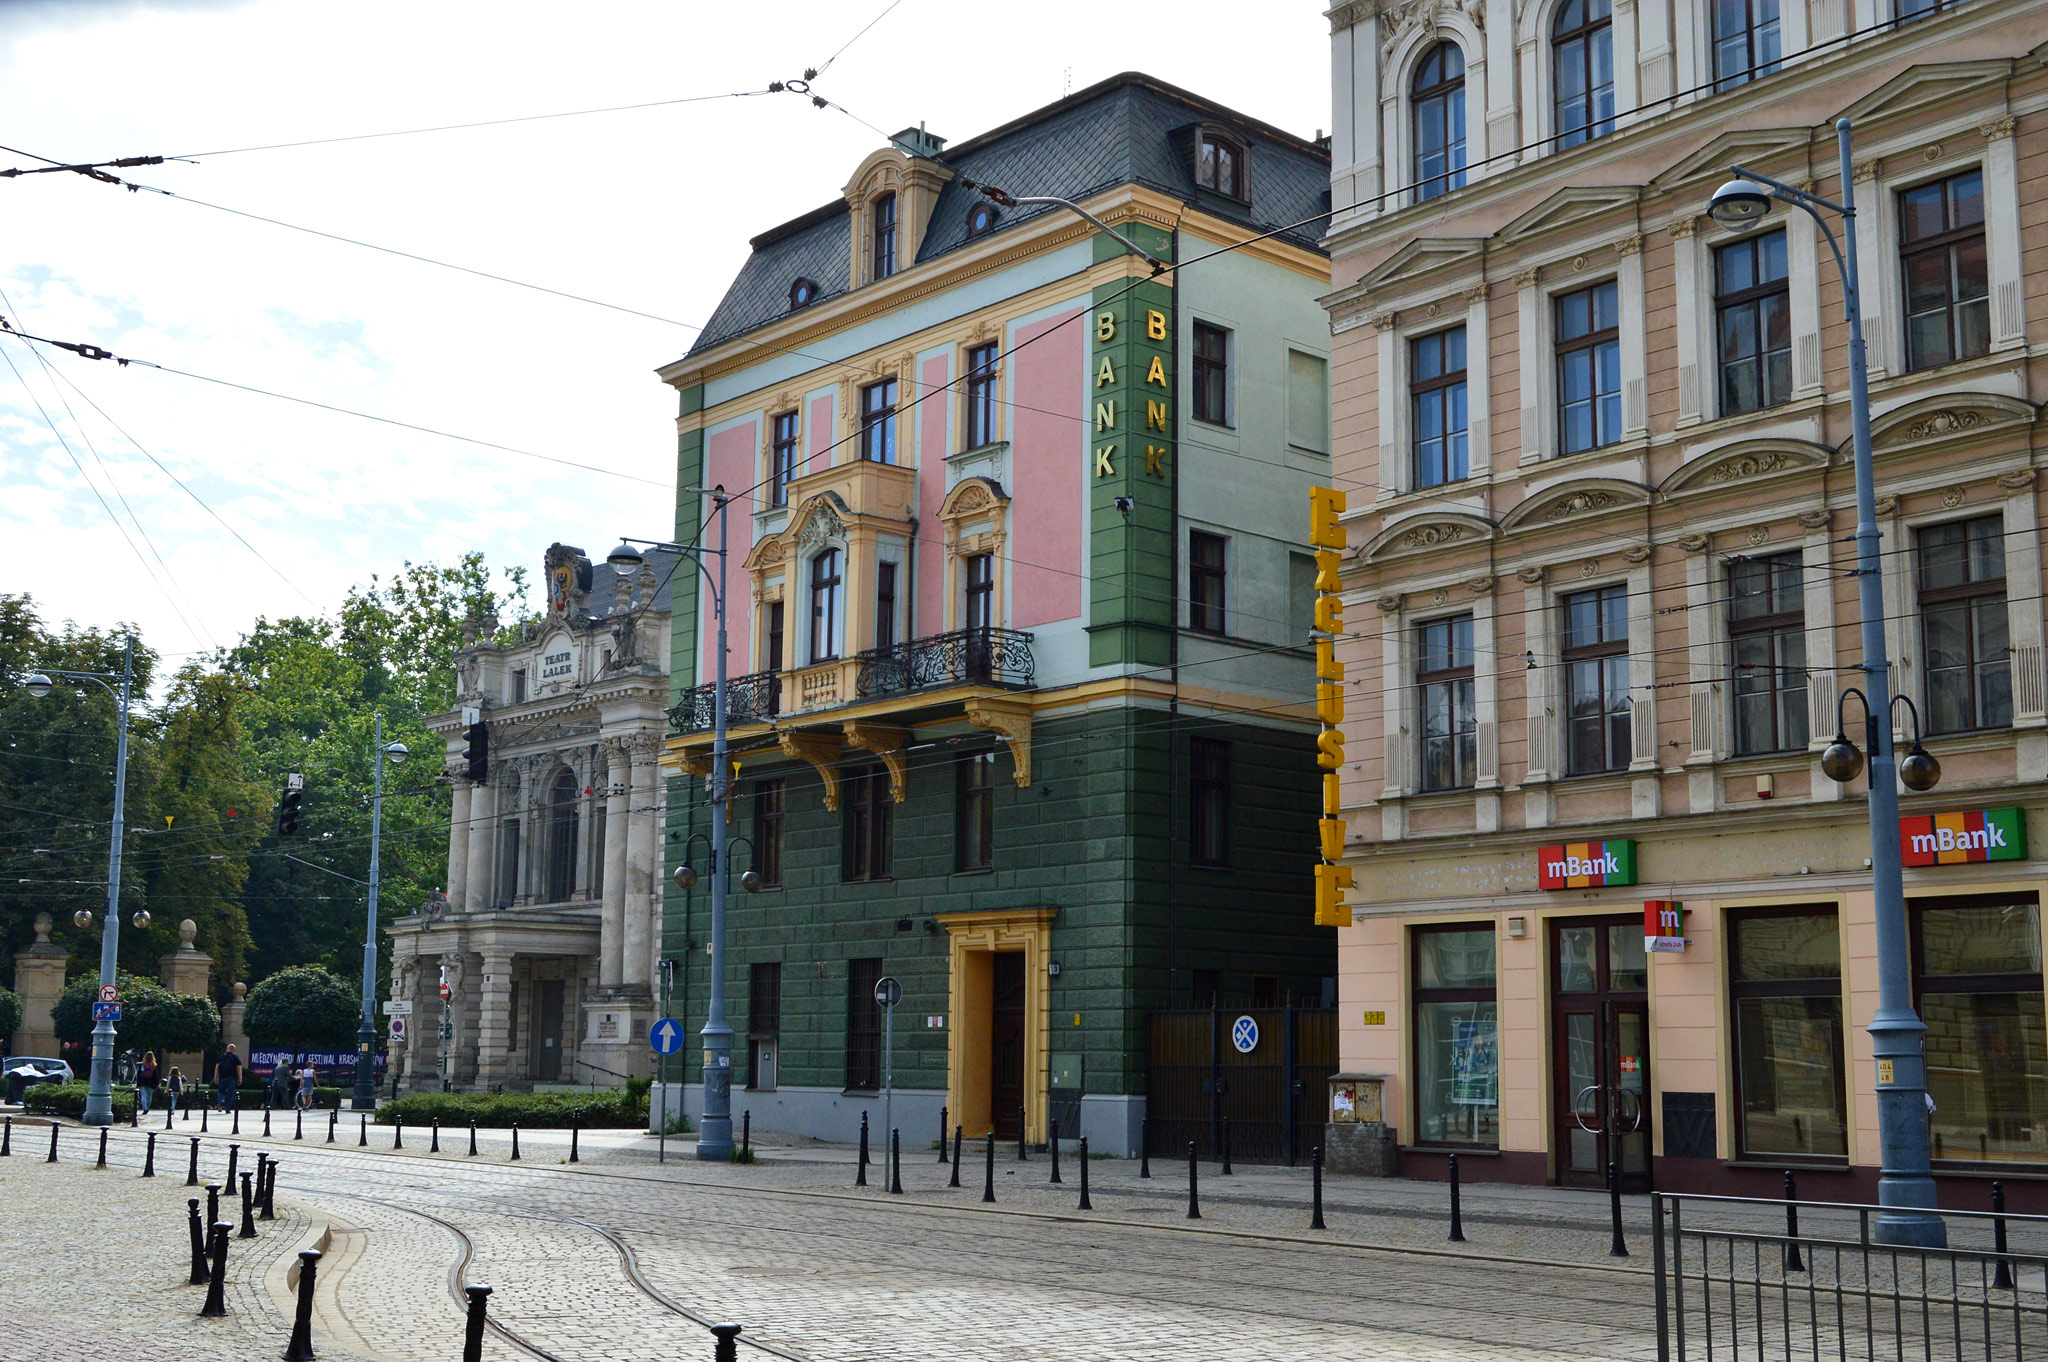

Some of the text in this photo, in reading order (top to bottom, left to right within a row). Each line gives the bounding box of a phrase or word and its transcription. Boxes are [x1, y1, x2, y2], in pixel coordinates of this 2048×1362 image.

[1096, 311, 1117, 478] BANK
[1146, 309, 1167, 479] BANK
[545, 652, 571, 665] TEATR
[543, 664, 572, 678] LALEK
[1309, 486, 1353, 928] EXCLUSIVE
[1911, 822, 2007, 853] mBank
[1547, 852, 1619, 878] mBank
[1660, 911, 1680, 928] m
[308, 1054, 335, 1065] FESTIWAL
[1621, 1060, 1640, 1069] mBank
